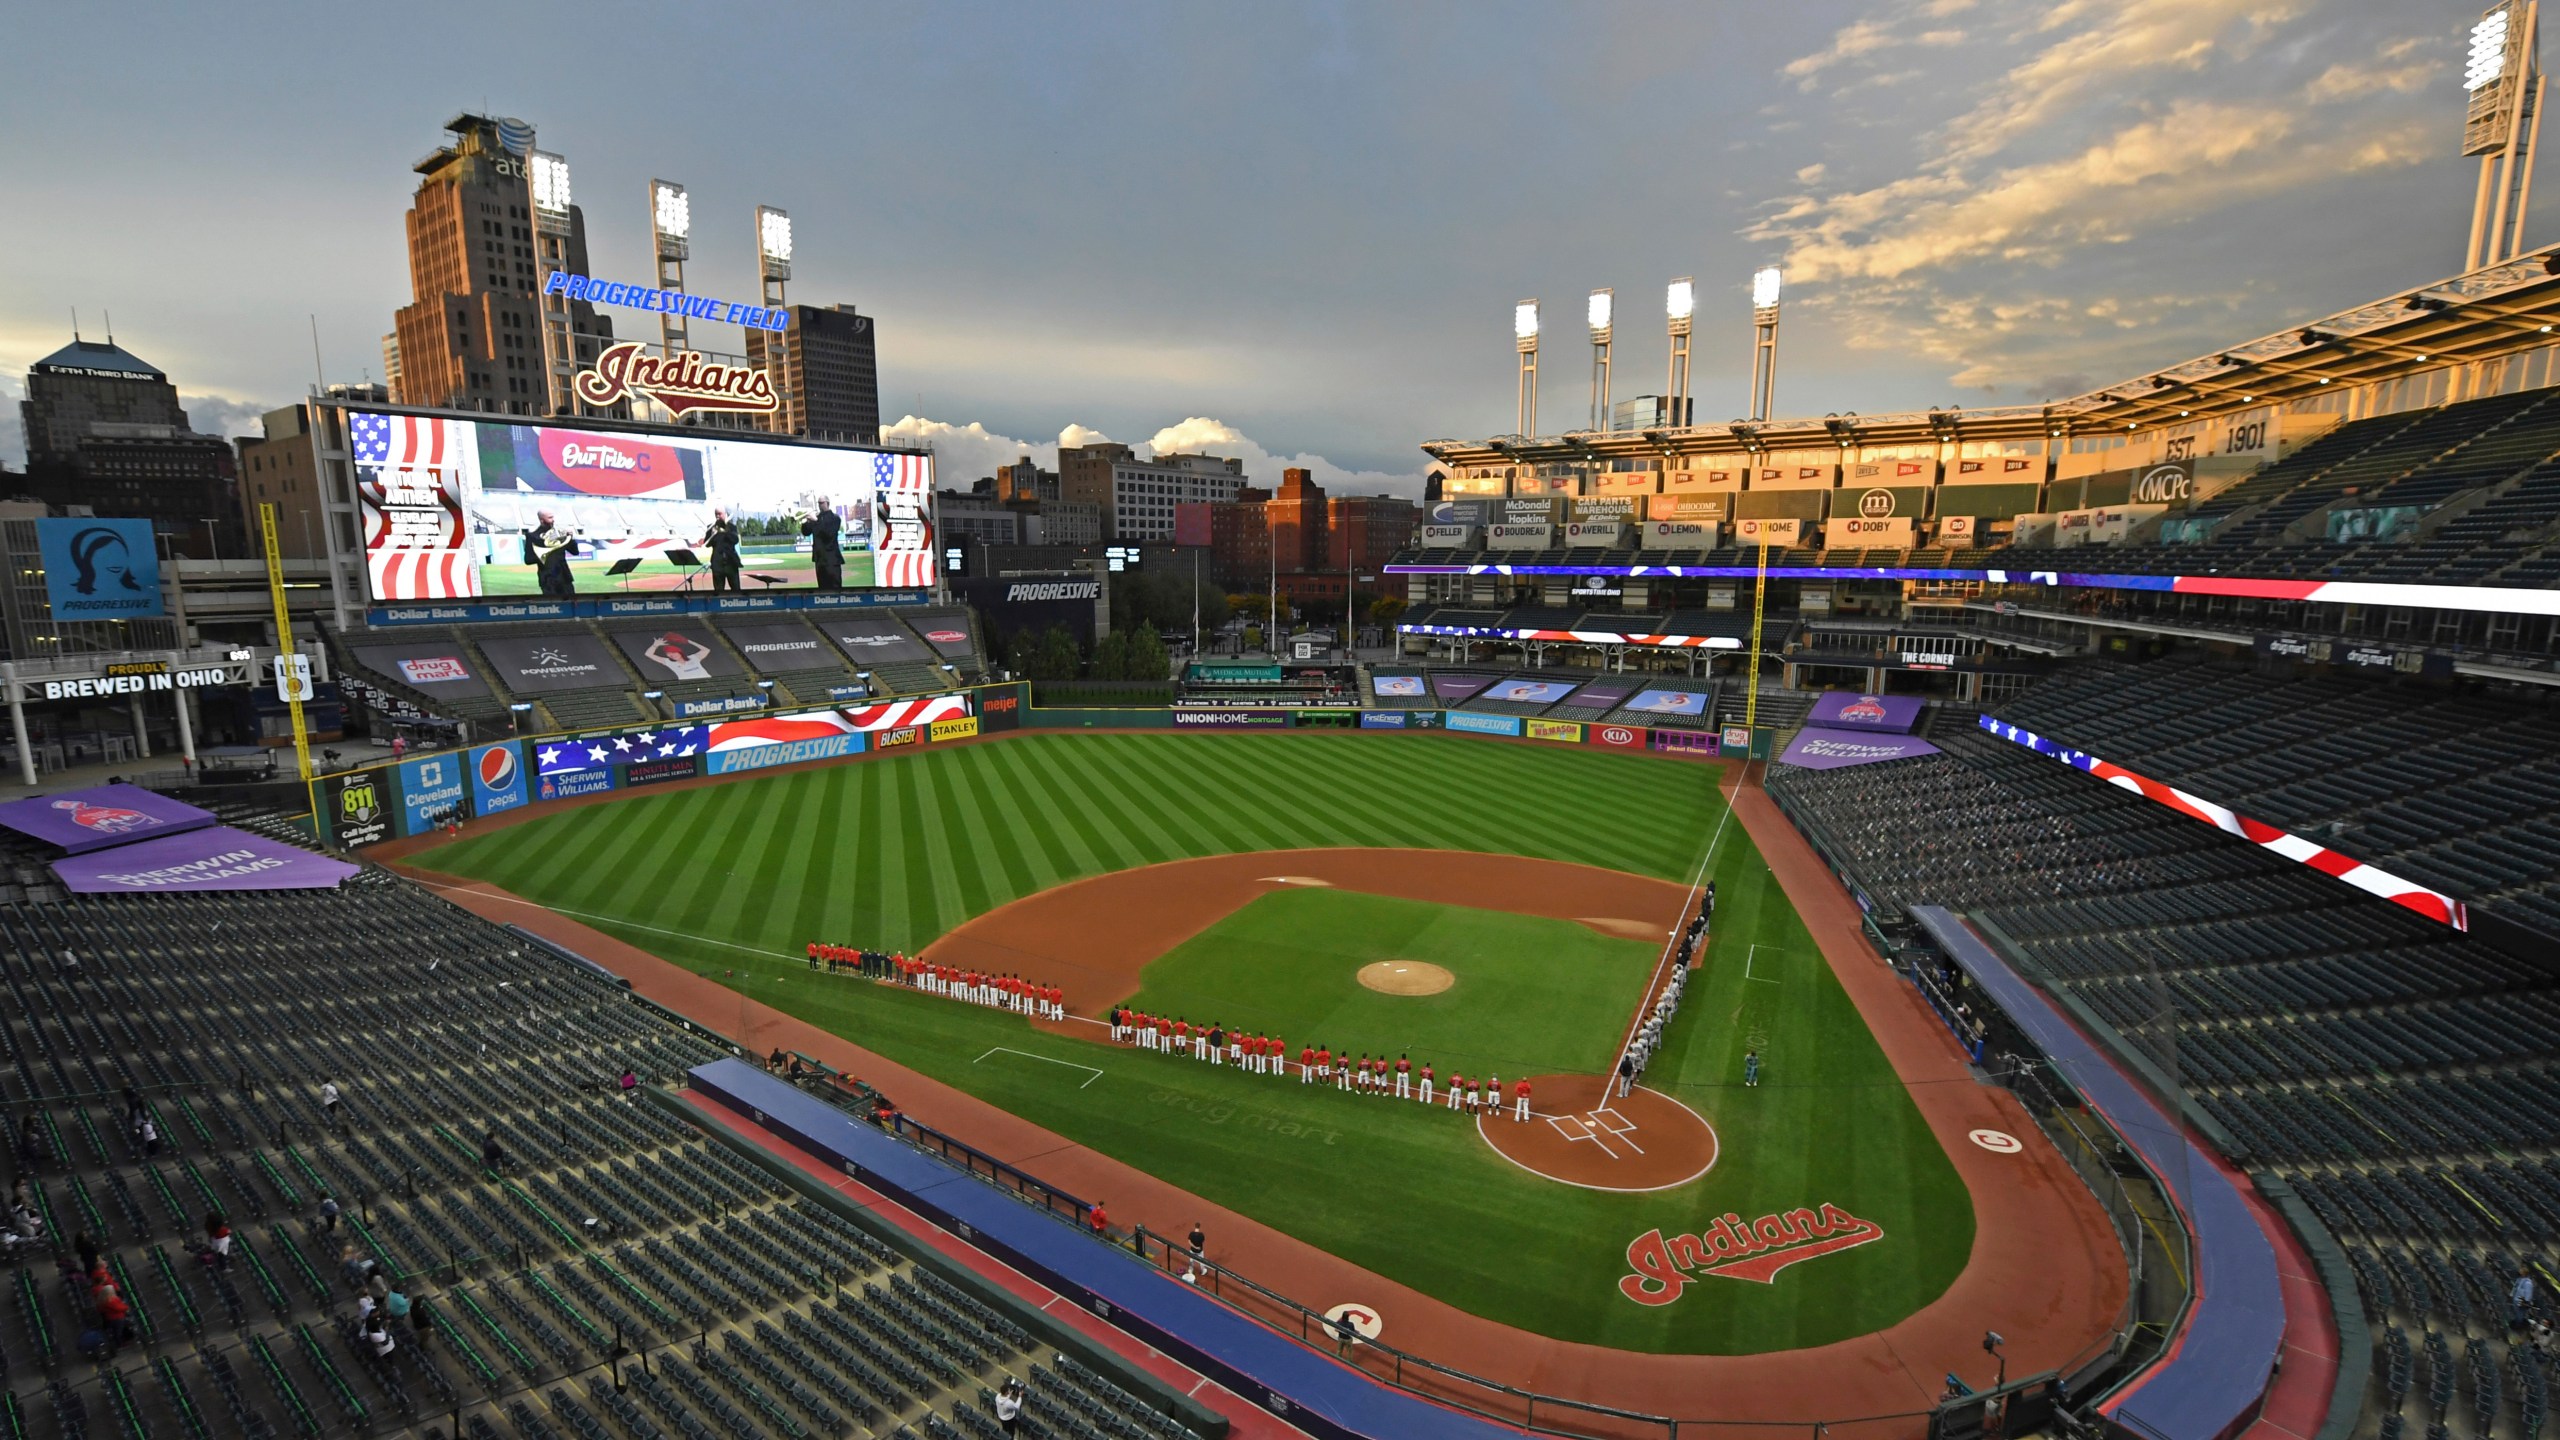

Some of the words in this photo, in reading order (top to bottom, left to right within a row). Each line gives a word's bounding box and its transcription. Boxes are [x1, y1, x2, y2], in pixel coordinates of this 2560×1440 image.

[544, 270, 720, 321] PROGRESSIVE
[724, 302, 790, 332] FIELD
[49, 365, 83, 375] FIFTH
[84, 368, 121, 378] THIRD
[122, 371, 155, 380] BANK
[576, 342, 779, 410] Indians
[2226, 421, 2266, 453] 1901
[2166, 435, 2196, 461] EST.
[562, 443, 597, 468] Our
[586, 445, 636, 469] Tribe
[637, 453, 651, 472] C
[1962, 463, 1978, 471] 2017
[2145, 474, 2190, 502] MCPc
[1505, 499, 1551, 510] McDonald
[1578, 498, 1598, 506] CAR
[1600, 497, 1632, 506] PARTS
[1575, 505, 1634, 514] WAREHOUSE
[1508, 514, 1546, 524] Hopkins
[1436, 528, 1463, 536] FELLER
[1505, 526, 1546, 536] BOUDREAU
[1581, 526, 1615, 534] AVERILL
[1671, 524, 1702, 534] LEMON
[1863, 521, 1891, 532] DOBY
[874, 594, 895, 602] Dollar
[896, 593, 919, 601] Bank
[1007, 582, 1101, 601] PROGRESSIVE
[63, 599, 152, 610] PROGRESSIVE
[720, 598, 747, 608] Dollar
[748, 598, 774, 606] Bank
[814, 596, 836, 604] Dollar
[838, 595, 862, 603] Bank
[489, 606, 526, 616] Dollar
[528, 604, 561, 614] Bank
[612, 601, 644, 612] Dollar
[646, 600, 674, 611] Bank
[388, 608, 430, 620] Dollar
[432, 608, 467, 618] Bank
[842, 636, 874, 644] Dollar
[745, 641, 817, 653] PROGRESSIVE
[406, 659, 453, 671] drug
[1902, 652, 1918, 662] THE
[1919, 652, 1954, 666] CORNER
[108, 661, 168, 675] PROUDLY
[416, 668, 465, 680] mart
[520, 664, 597, 676] POWERHOME
[1212, 668, 1242, 676] MEDICAL
[45, 675, 145, 700] BREWED
[150, 673, 173, 690] IN
[176, 668, 225, 688] OHIO
[685, 701, 724, 714] Dollar
[725, 698, 757, 710] Bank
[984, 696, 1017, 712] meijer
[1176, 714, 1248, 723] UNIONHOME
[1364, 714, 1404, 724] FirstEnergy
[1450, 716, 1514, 730] PROGRESSIVE
[932, 722, 976, 736] STANLEY
[1726, 728, 1744, 739] drug
[880, 728, 917, 748] BLASTER
[1607, 731, 1628, 741] KIA
[1686, 746, 1708, 754] fitness
[1808, 740, 1905, 752] SHERWIN
[721, 735, 851, 773] PROGRESSIVE
[630, 763, 670, 776] MINUTE
[672, 760, 694, 769] MEN
[558, 770, 607, 786] SHERWIN
[645, 772, 670, 780] STAFFING
[343, 786, 374, 813] 811
[406, 782, 462, 807] Cleveland
[488, 791, 517, 810] pepsi
[420, 803, 453, 819] Clinic
[342, 828, 358, 839] Call
[358, 822, 385, 835] before
[349, 836, 364, 848] you
[364, 832, 381, 842] dig.
[97, 850, 257, 884] SHERWIN
[1240, 1113, 1343, 1145] mart
[1619, 1202, 1884, 1306] Indians
